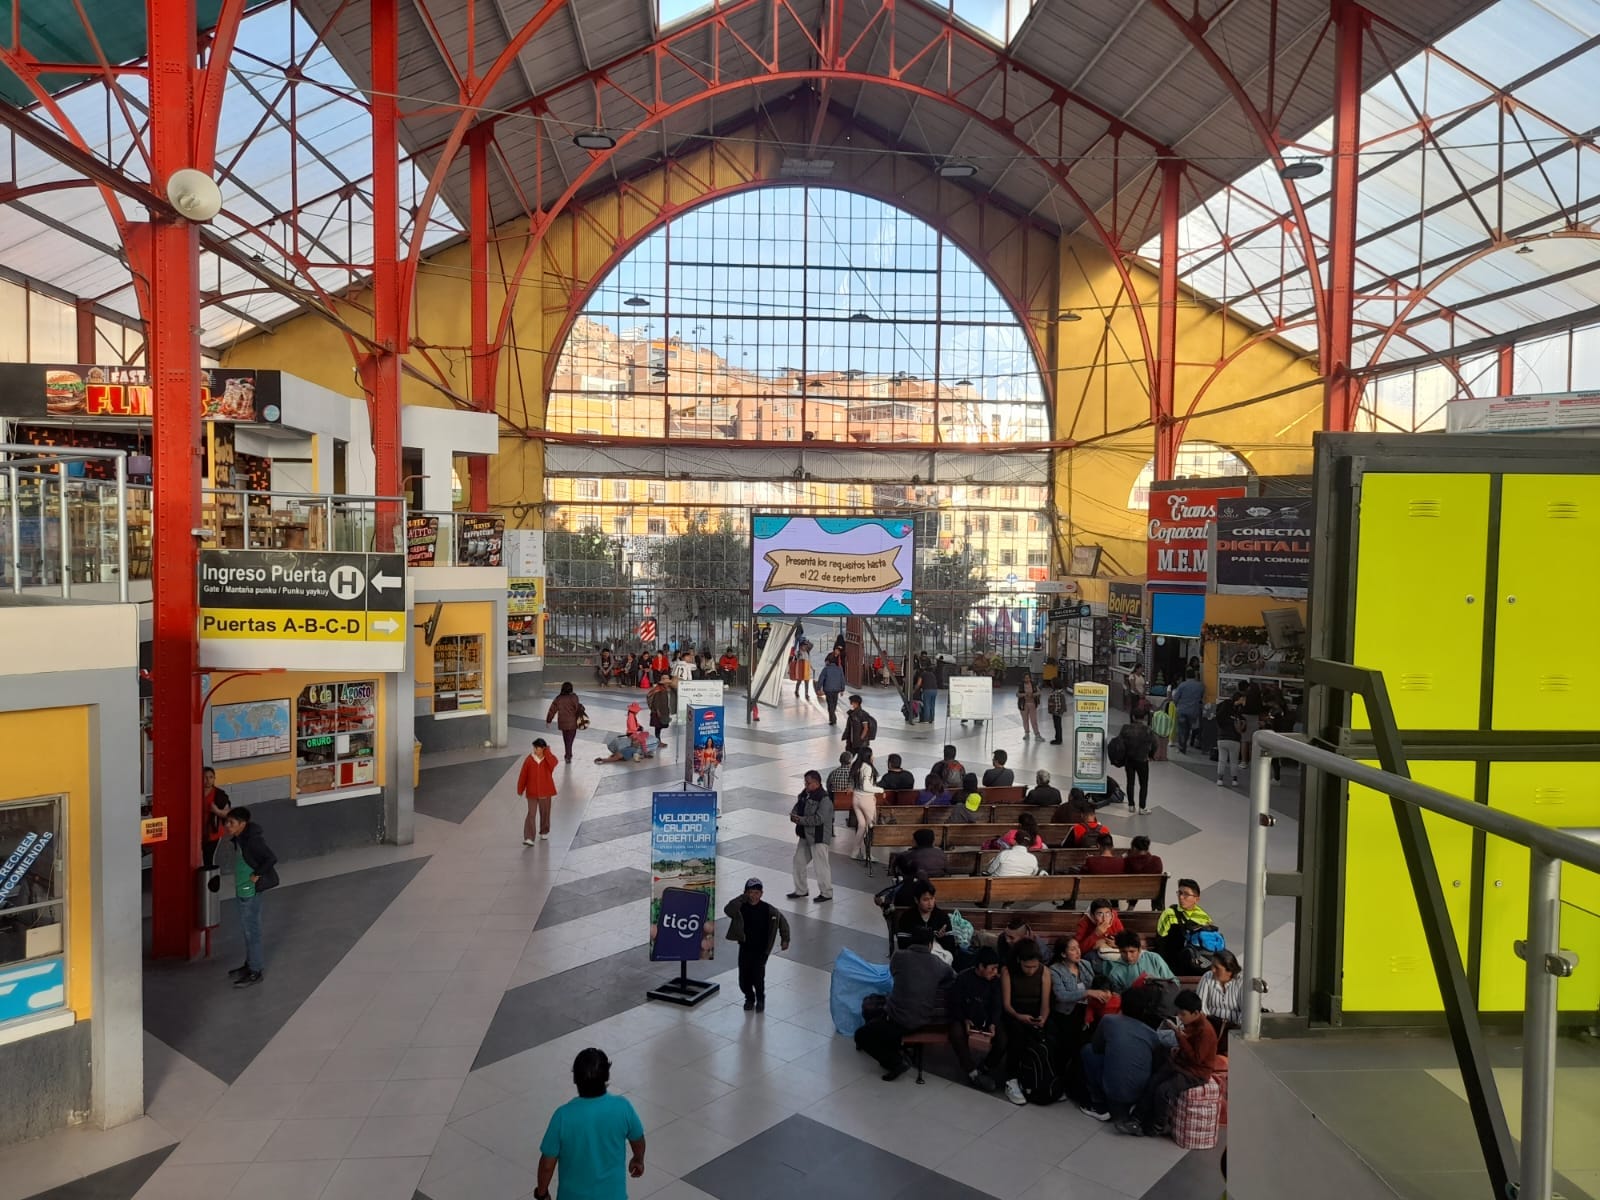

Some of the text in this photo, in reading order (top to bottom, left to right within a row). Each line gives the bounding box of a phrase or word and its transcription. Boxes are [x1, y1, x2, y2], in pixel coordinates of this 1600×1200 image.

[111, 370, 146, 383] FAST
[1167, 495, 1217, 521] Trans
[1231, 528, 1311, 537] CONECTA
[785, 555, 887, 571] Presenta los requisitos hasta
[202, 563, 358, 594] Ingreso Puerta H
[799, 569, 876, 584] el 22 de septiembre
[203, 585, 220, 593] Gate
[255, 586, 277, 596] punku
[282, 587, 304, 595] Punku
[305, 587, 330, 597] yaykuy
[203, 616, 360, 634] Puertas A-B-C-D
[309, 684, 371, 705] 6 de Agosto
[306, 736, 332, 748] ORURO
[658, 813, 710, 823] VELOCIDAD
[663, 823, 703, 833] CALIDAD
[656, 833, 712, 843] COBERTURA
[663, 913, 700, 932] tigo
